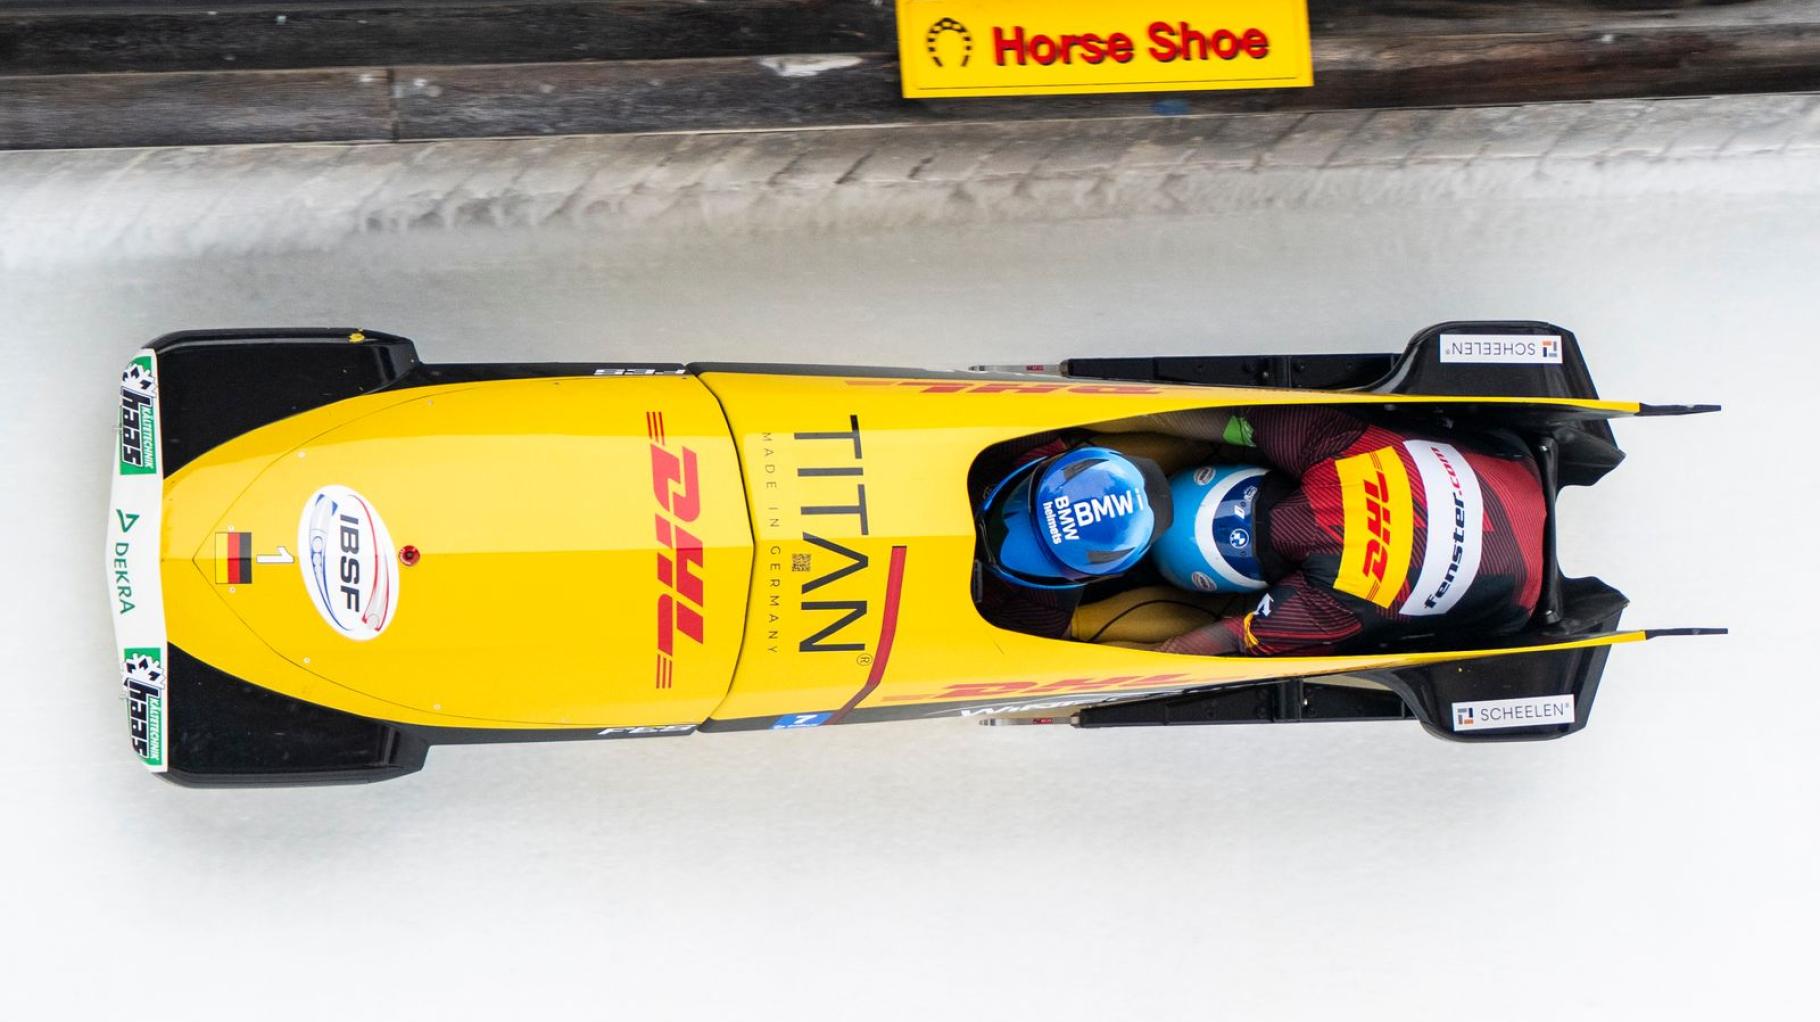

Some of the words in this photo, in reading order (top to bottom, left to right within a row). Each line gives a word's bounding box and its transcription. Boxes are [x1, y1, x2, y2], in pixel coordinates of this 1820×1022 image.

[993, 26, 1135, 66] Horse
[1148, 21, 1270, 64] Shoe
[762, 431, 777, 489] MADE
[768, 506, 780, 528] IN
[1042, 501, 1063, 545] helmets
[1054, 495, 1080, 541] BMW
[1073, 490, 1134, 527] BMW
[1134, 487, 1144, 512] i
[1362, 470, 1391, 583] DHL
[256, 545, 296, 565] 1
[336, 513, 361, 613] IBSF
[649, 443, 704, 656] DHL
[113, 541, 136, 615] DEKRA
[767, 545, 781, 653] GERMANY
[931, 672, 1195, 699] DHL
